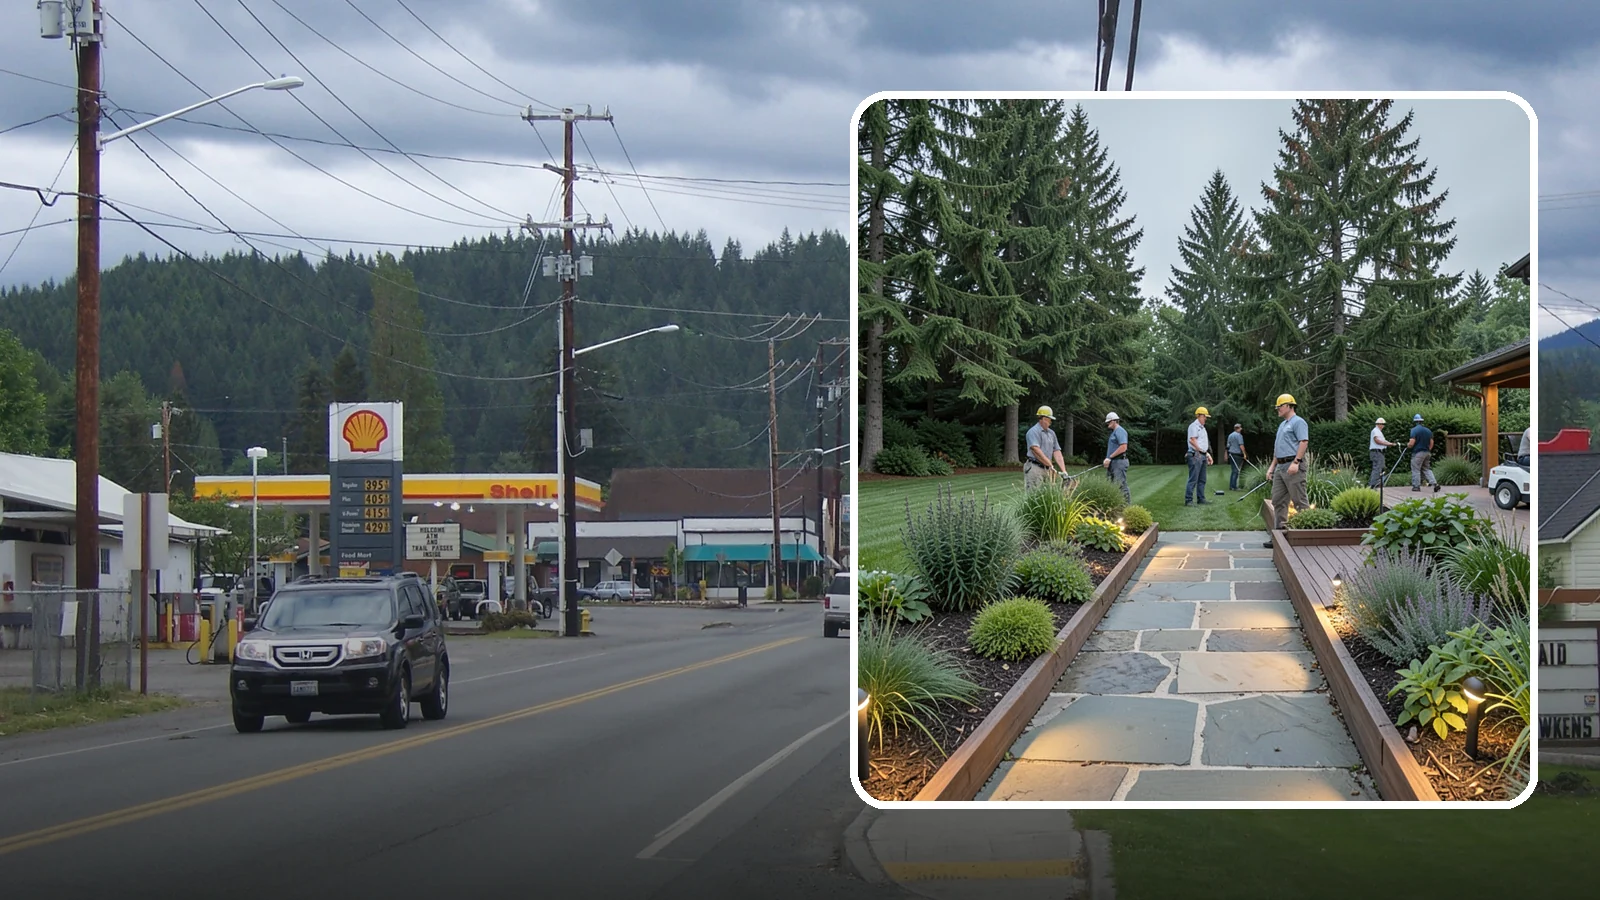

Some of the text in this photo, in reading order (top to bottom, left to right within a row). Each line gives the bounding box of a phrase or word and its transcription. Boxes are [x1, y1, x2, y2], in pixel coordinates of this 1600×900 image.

[366, 480, 384, 490] 395
[490, 484, 547, 499] Shell
[365, 494, 384, 504] 405
[365, 508, 384, 518] 415
[365, 522, 384, 533] 429
